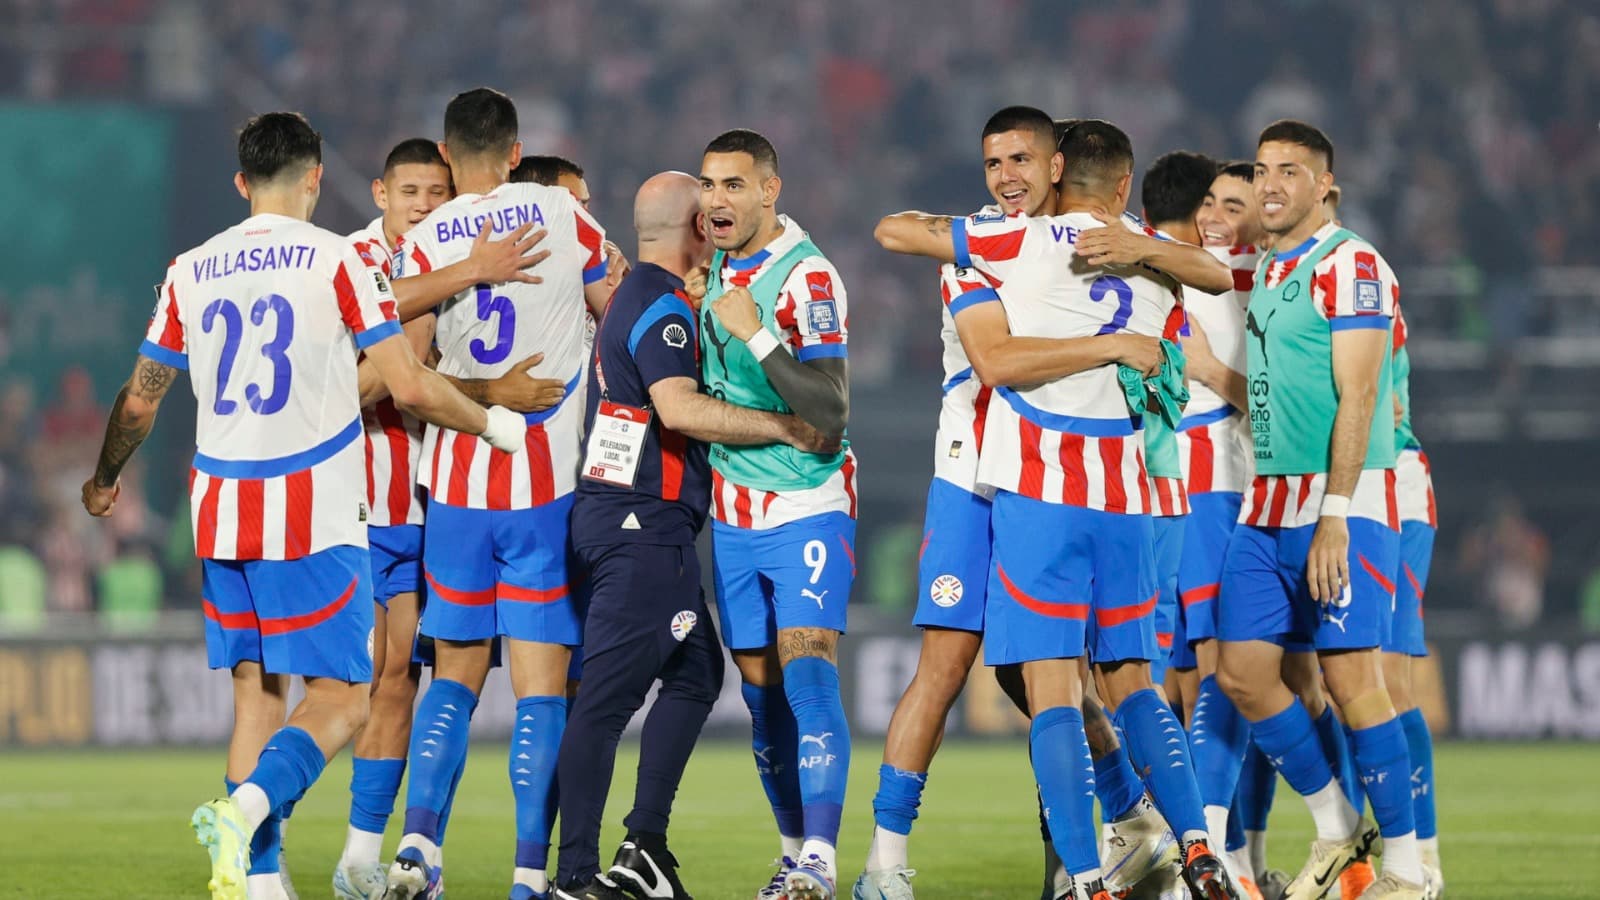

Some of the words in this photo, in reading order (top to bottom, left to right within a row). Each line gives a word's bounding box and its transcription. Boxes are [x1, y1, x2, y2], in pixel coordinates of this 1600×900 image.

[194, 245, 316, 284] VILLASANTI
[469, 283, 515, 365] 5
[201, 294, 294, 415] 23
[1248, 372, 1269, 397] igo
[1250, 409, 1271, 422] eno
[1251, 422, 1271, 433] LSEN
[803, 539, 827, 585] 9
[799, 753, 836, 769] APF
